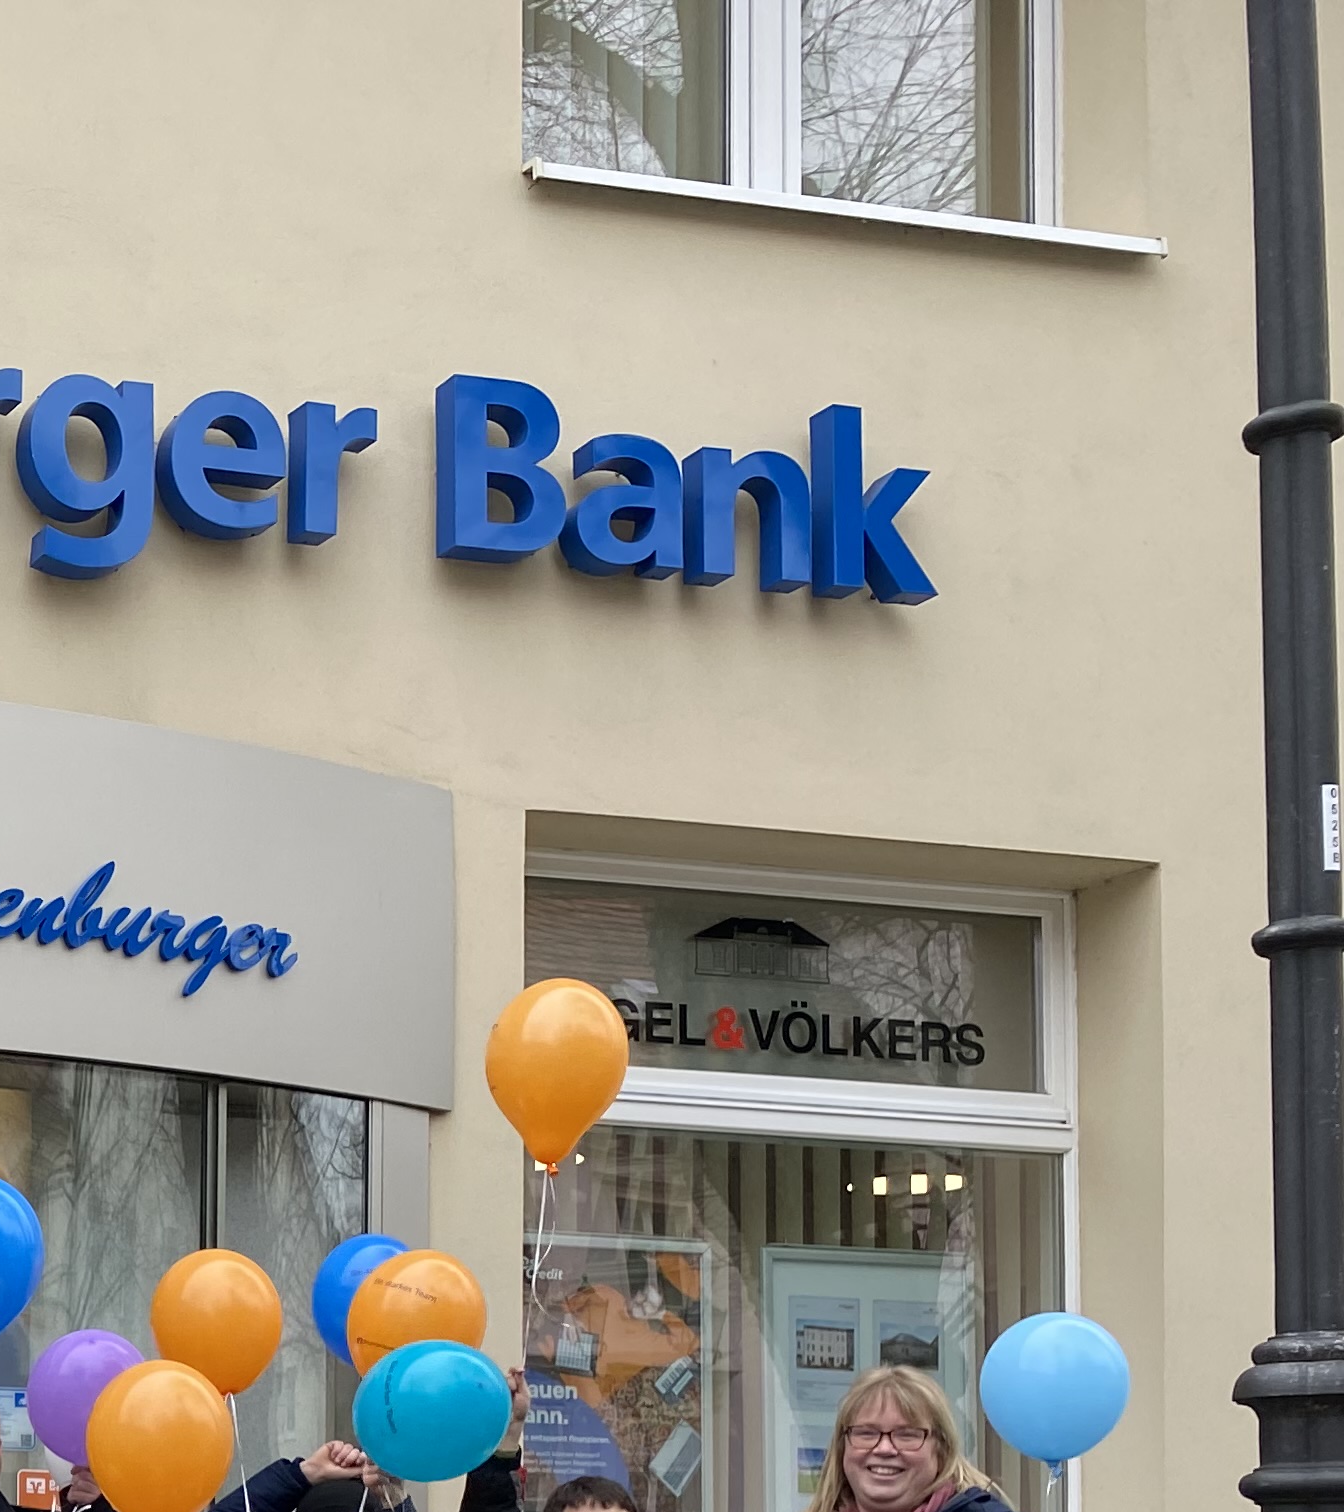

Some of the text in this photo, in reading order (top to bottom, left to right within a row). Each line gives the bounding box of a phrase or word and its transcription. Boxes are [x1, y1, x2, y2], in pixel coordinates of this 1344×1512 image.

[436, 375, 936, 604] Bank
[529, 1382, 578, 1401] auen
[526, 1407, 570, 1425] ann.
